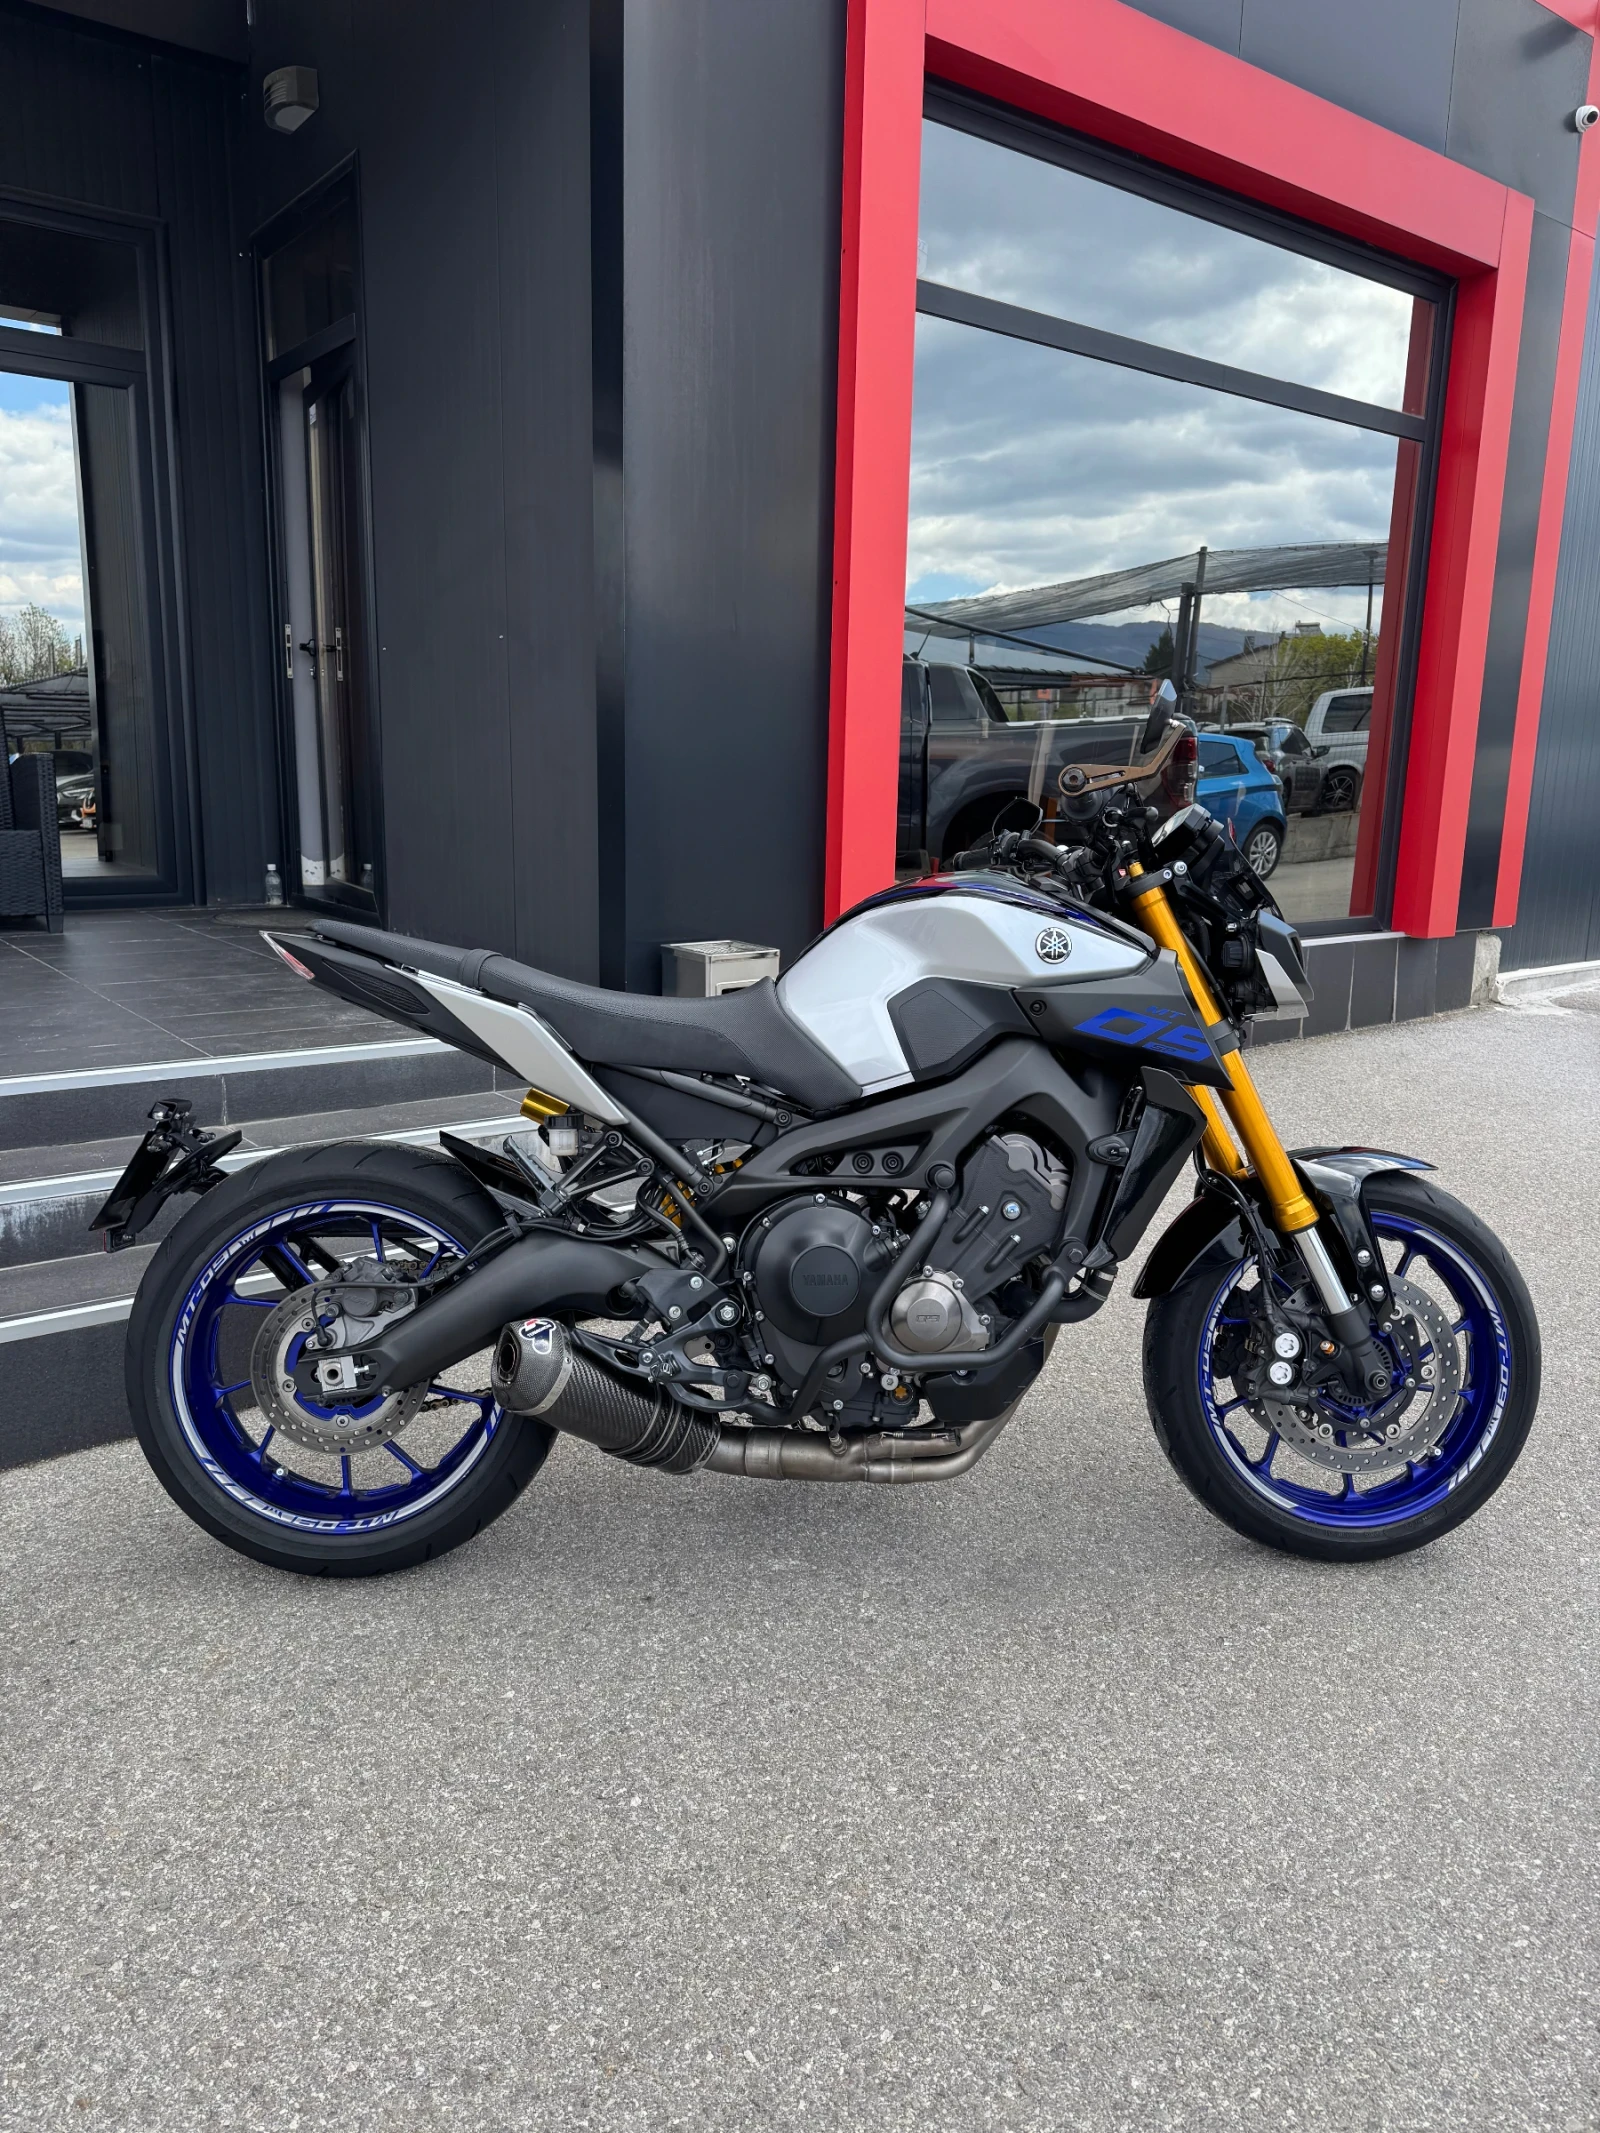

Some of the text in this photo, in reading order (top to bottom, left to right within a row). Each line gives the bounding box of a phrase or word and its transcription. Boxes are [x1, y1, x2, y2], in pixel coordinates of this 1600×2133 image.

[1145, 1005, 1186, 1019] MT
[1073, 1007, 1213, 1062] 09
[178, 1249, 230, 1344] MT-09
[802, 1274, 849, 1286] YAMAHA
[1490, 1311, 1509, 1408] MT-09
[293, 1510, 398, 1530] MT-09
